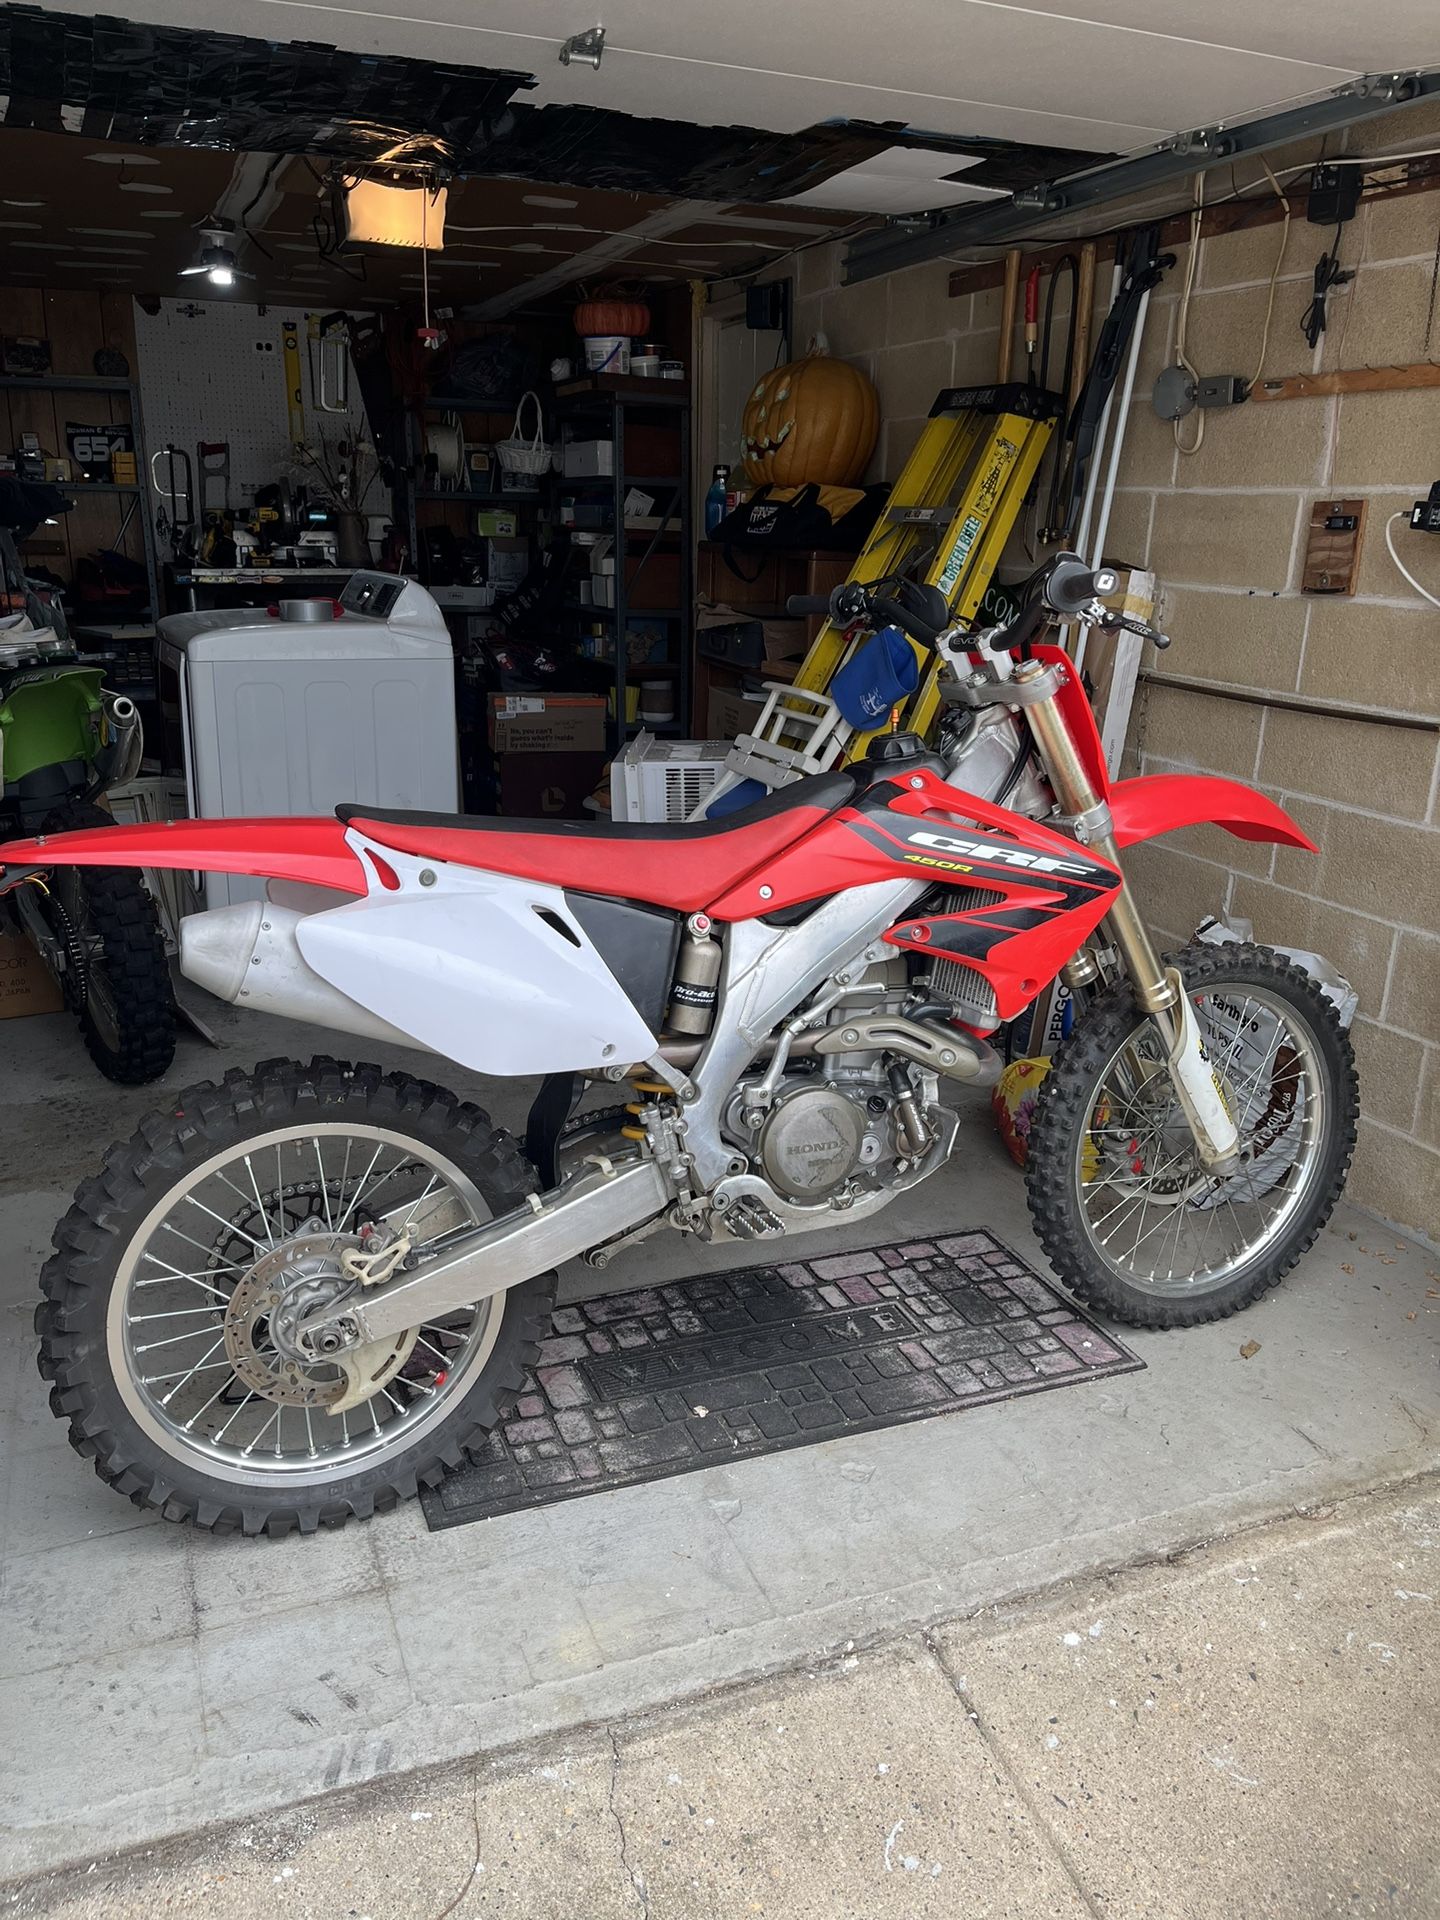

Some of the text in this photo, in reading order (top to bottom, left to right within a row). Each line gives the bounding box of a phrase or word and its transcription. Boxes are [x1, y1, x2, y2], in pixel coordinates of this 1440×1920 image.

[944, 545, 967, 582] GREEN
[980, 588, 1021, 628] COM
[1124, 621, 1153, 635] ARC
[903, 855, 975, 873] 450R
[906, 831, 1098, 875] CRF
[1047, 984, 1072, 1042] PERGO
[786, 1140, 850, 1156] HONDA
[602, 1311, 907, 1388] WELCOME
